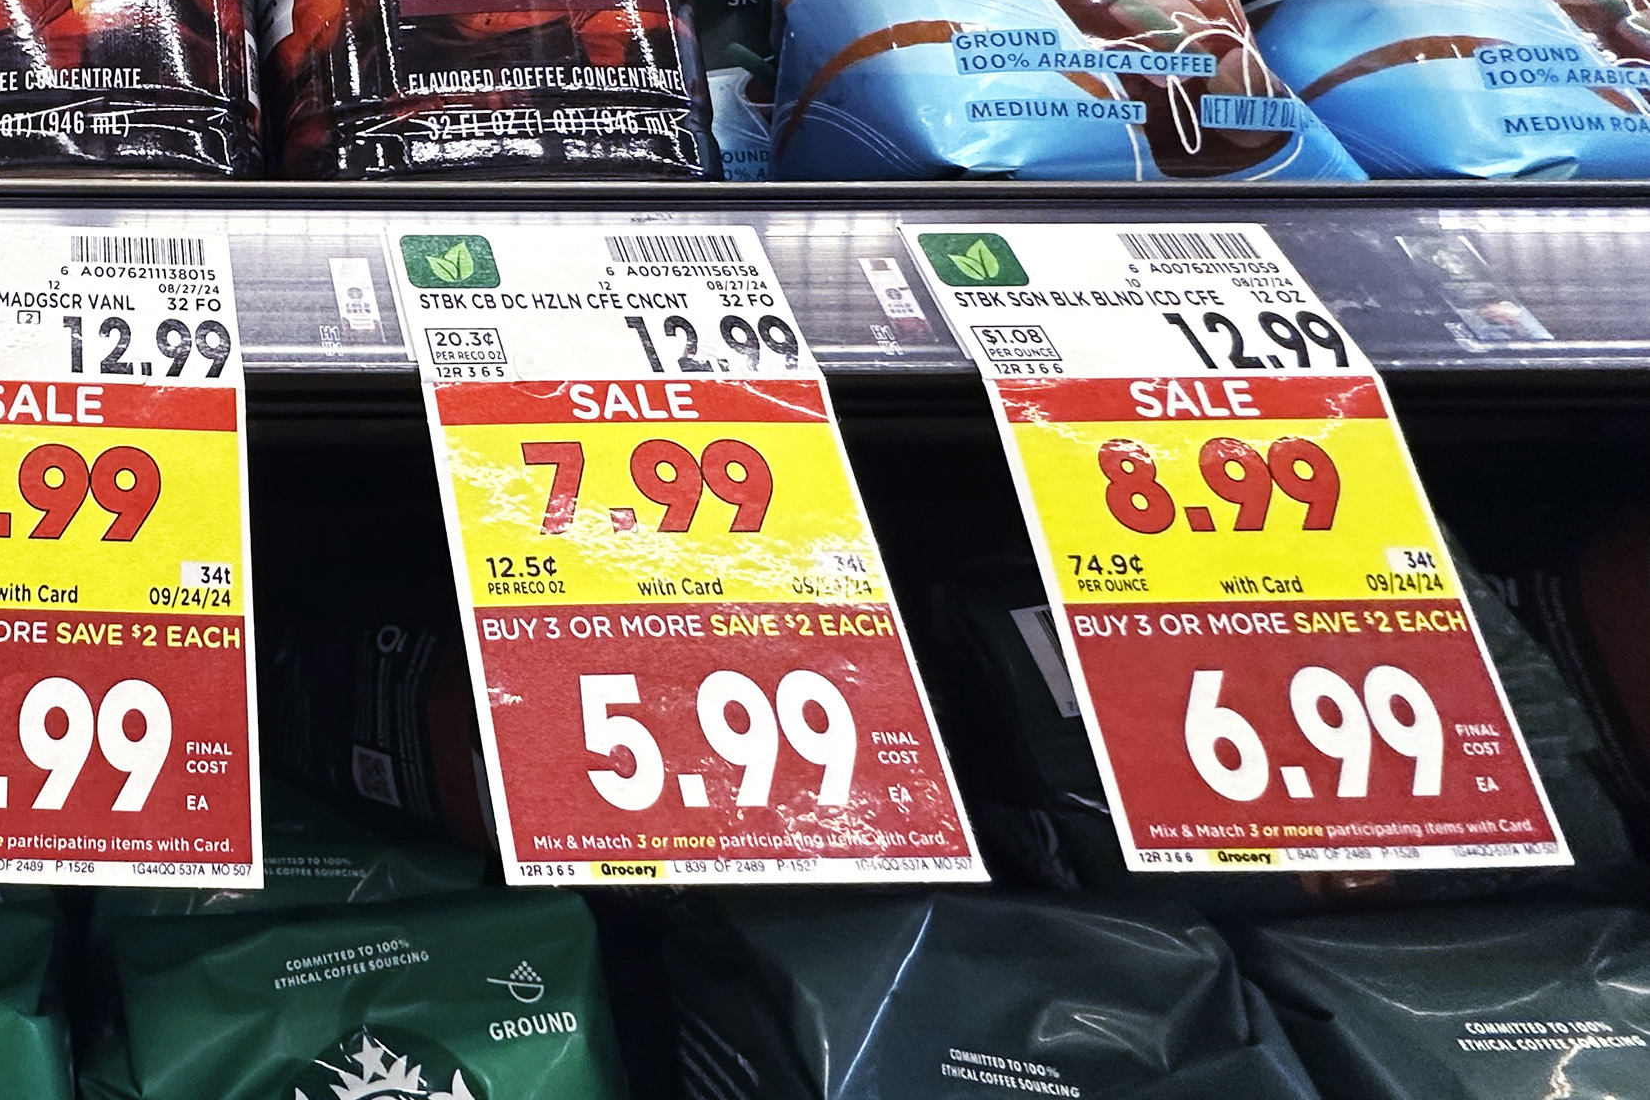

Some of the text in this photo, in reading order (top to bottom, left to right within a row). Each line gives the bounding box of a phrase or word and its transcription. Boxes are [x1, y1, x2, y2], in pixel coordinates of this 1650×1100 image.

[954, 29, 1057, 49] GROUND
[957, 51, 1214, 73] 100% ARABICA COFFEE
[24, 68, 142, 94] CONCENTRATE
[970, 99, 1143, 121] MEDIUM ROAST
[1504, 115, 1606, 135] MEDIUM
[63, 316, 231, 379] 12.99
[1162, 311, 1351, 370] 12.99
[569, 383, 700, 420] SALE
[1129, 381, 1261, 418] SALE
[521, 438, 774, 535] 7.99
[1097, 437, 1341, 535] 8.99
[578, 669, 858, 811] 5.99
[1184, 665, 1445, 802] 6.99
[274, 950, 430, 990] ETHICAL COFFEE SOURCING
[285, 939, 410, 972] COMMITTED TO 100%
[488, 1011, 578, 1042] GROUND
